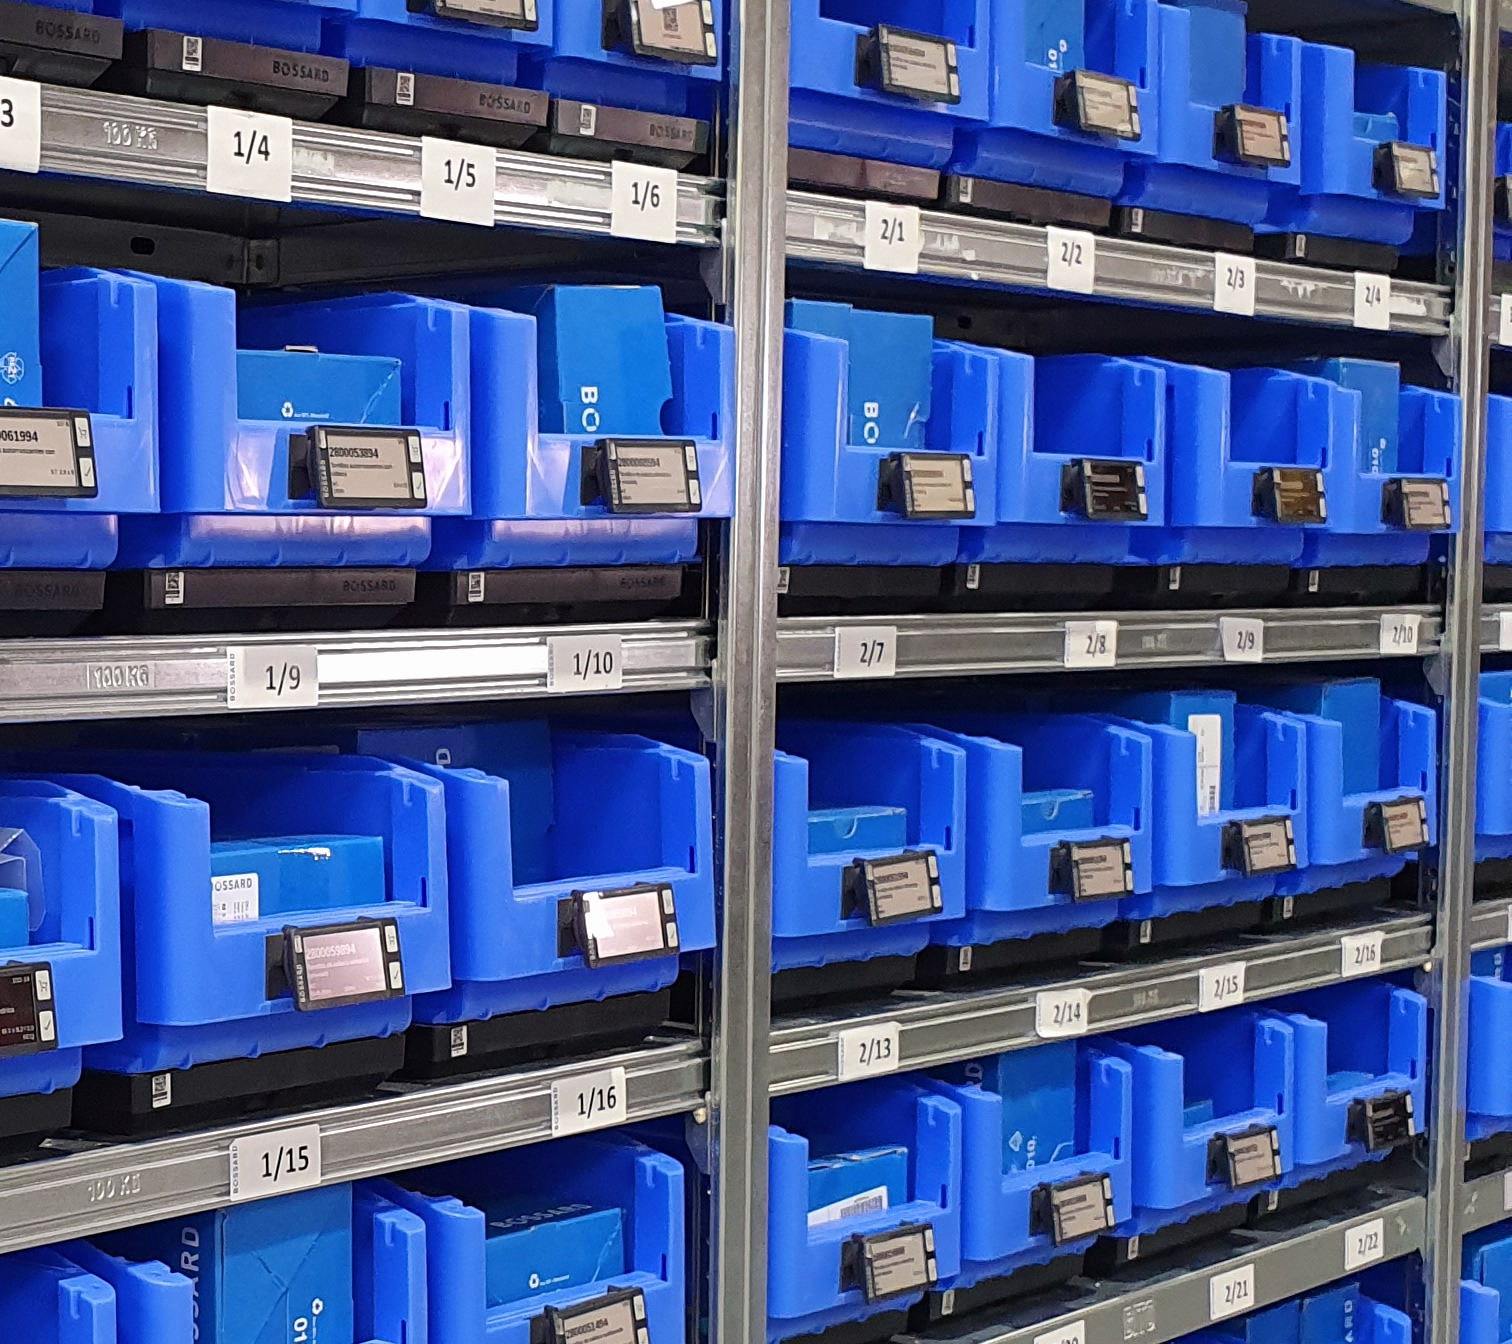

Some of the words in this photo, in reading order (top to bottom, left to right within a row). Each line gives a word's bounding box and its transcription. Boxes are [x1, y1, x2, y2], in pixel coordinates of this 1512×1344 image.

[36, 20, 100, 44] BOSSARD
[273, 60, 329, 82] BOSSARD
[479, 92, 530, 114] BOSSARD
[233, 130, 270, 164] 1/4
[444, 159, 476, 191] 1/5
[632, 181, 660, 210] 1/6
[881, 218, 905, 245] 2/1
[1061, 242, 1082, 266] 2/2
[1226, 267, 1245, 290] 2/3
[1366, 285, 1381, 307] 2/4
[1086, 634, 1106, 657] 2/8
[1237, 630, 1254, 653] 2/9
[1392, 625, 1412, 644] 2/10
[573, 651, 613, 677] 1/10
[860, 640, 884, 665] 2/7
[229, 653, 237, 702] BOSSARD
[264, 663, 301, 691] 1/9
[212, 878, 252, 891] OSSARD
[1355, 943, 1376, 965] 2/16
[1214, 977, 1238, 999] 2/15
[1053, 1001, 1081, 1025] 2/14
[860, 1038, 890, 1065] 2/13
[578, 1085, 616, 1119] 1/16
[261, 1145, 309, 1182] 1/15
[1358, 1231, 1378, 1256] 2/22
[1226, 1279, 1248, 1303] 2/21
